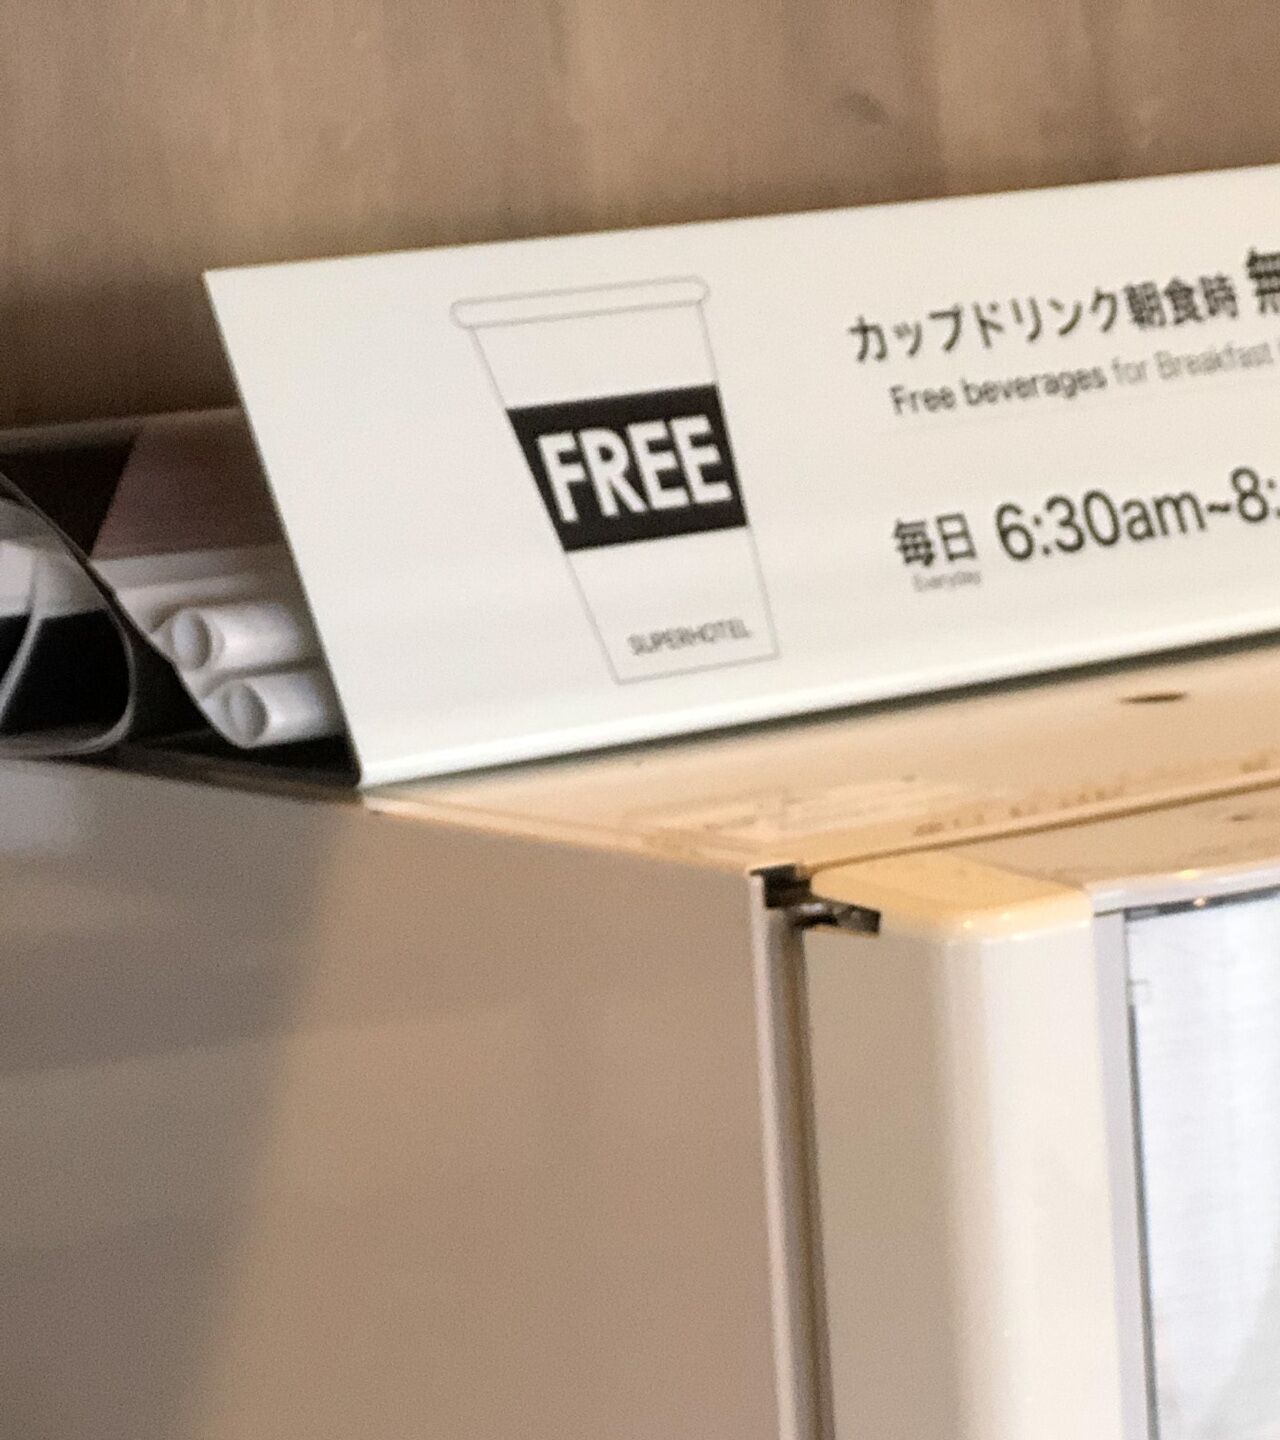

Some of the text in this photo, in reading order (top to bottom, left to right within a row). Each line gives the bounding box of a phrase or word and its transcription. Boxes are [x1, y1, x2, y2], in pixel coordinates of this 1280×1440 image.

[849, 273, 1241, 364] カップドリンク朝食時
[890, 379, 957, 417] Free
[963, 360, 1108, 409] beverages
[1112, 349, 1149, 386] for
[1154, 338, 1276, 382] Breakfast
[536, 413, 733, 524] FREE
[892, 512, 979, 570] 毎日
[911, 571, 983, 595] Everyday
[628, 617, 754, 657] SUPERHOTEL
